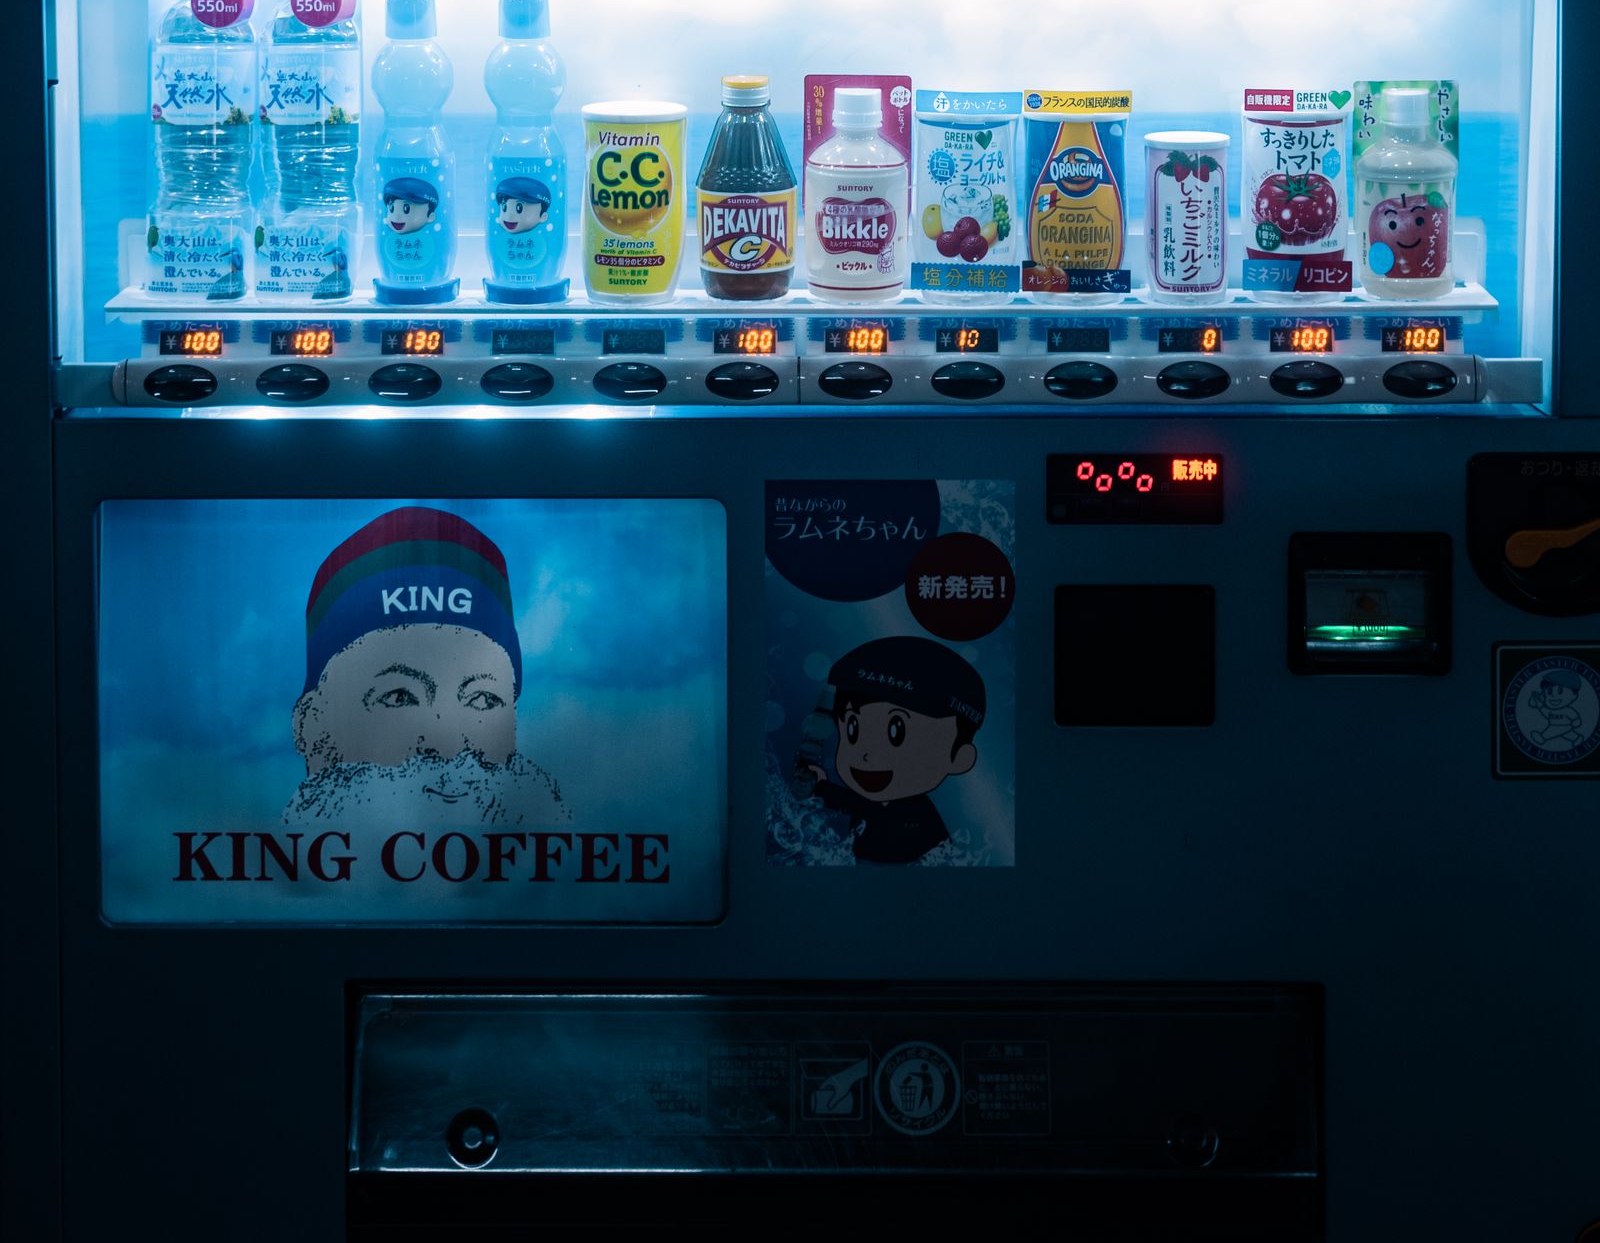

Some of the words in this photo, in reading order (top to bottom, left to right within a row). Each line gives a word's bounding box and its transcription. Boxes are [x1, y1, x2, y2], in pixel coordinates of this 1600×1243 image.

[197, 0, 239, 14] 550ml
[296, 0, 336, 14] 550ml
[161, 82, 235, 111] 天然水
[265, 82, 334, 111] 天然水
[935, 96, 1008, 111] 汗をかいたら
[1043, 95, 1130, 109] フランスの国民的炭酸
[1297, 92, 1327, 103] GREEN
[1359, 94, 1376, 140] 味わい
[598, 131, 660, 147] Vitamin
[944, 130, 973, 143] GREEN
[1260, 128, 1336, 149] すっきりした
[597, 151, 665, 188] C.C.
[960, 150, 1005, 173] ライチ&
[1049, 159, 1104, 182] ORANGINA
[1276, 150, 1322, 171] トマト
[591, 184, 669, 210] Lemon
[837, 185, 874, 193] SUNTORY
[703, 205, 787, 250] DEKAVITA
[822, 216, 889, 240] Bikkle
[1059, 213, 1095, 224] SODA
[164, 235, 223, 248] 奥大山は、
[269, 235, 326, 248] 奥大山は、
[1041, 226, 1112, 245] ORANGINA
[1180, 182, 1205, 282] いちごミルク
[728, 235, 763, 263] C
[1164, 227, 1176, 277] 乳飲料
[165, 265, 222, 278] 澄んでいる。
[271, 265, 327, 278] 澄んでいる。
[924, 268, 1009, 287] 塩分補給
[1247, 266, 1294, 282] ミネラル
[1304, 268, 1348, 284] リコピン
[608, 278, 649, 286] SUNTORY
[1172, 285, 1211, 293] SUNTORY
[184, 331, 220, 351] 100
[295, 331, 331, 351] 100
[405, 331, 441, 351] 130
[739, 330, 774, 350] 100
[848, 329, 884, 348] 100
[960, 329, 980, 349] 10
[1204, 329, 1217, 349] 0
[1292, 329, 1328, 348] 100
[1404, 329, 1440, 348] 100
[1171, 459, 1218, 481] 販売中
[775, 497, 847, 513] 昔ながらの
[773, 515, 928, 541] ラムネちゃん
[918, 575, 1008, 601] 新発売!
[381, 585, 474, 616] KING
[856, 668, 914, 692] ラムネちゃん
[172, 831, 359, 883] KING
[379, 830, 672, 885] COFFEE
